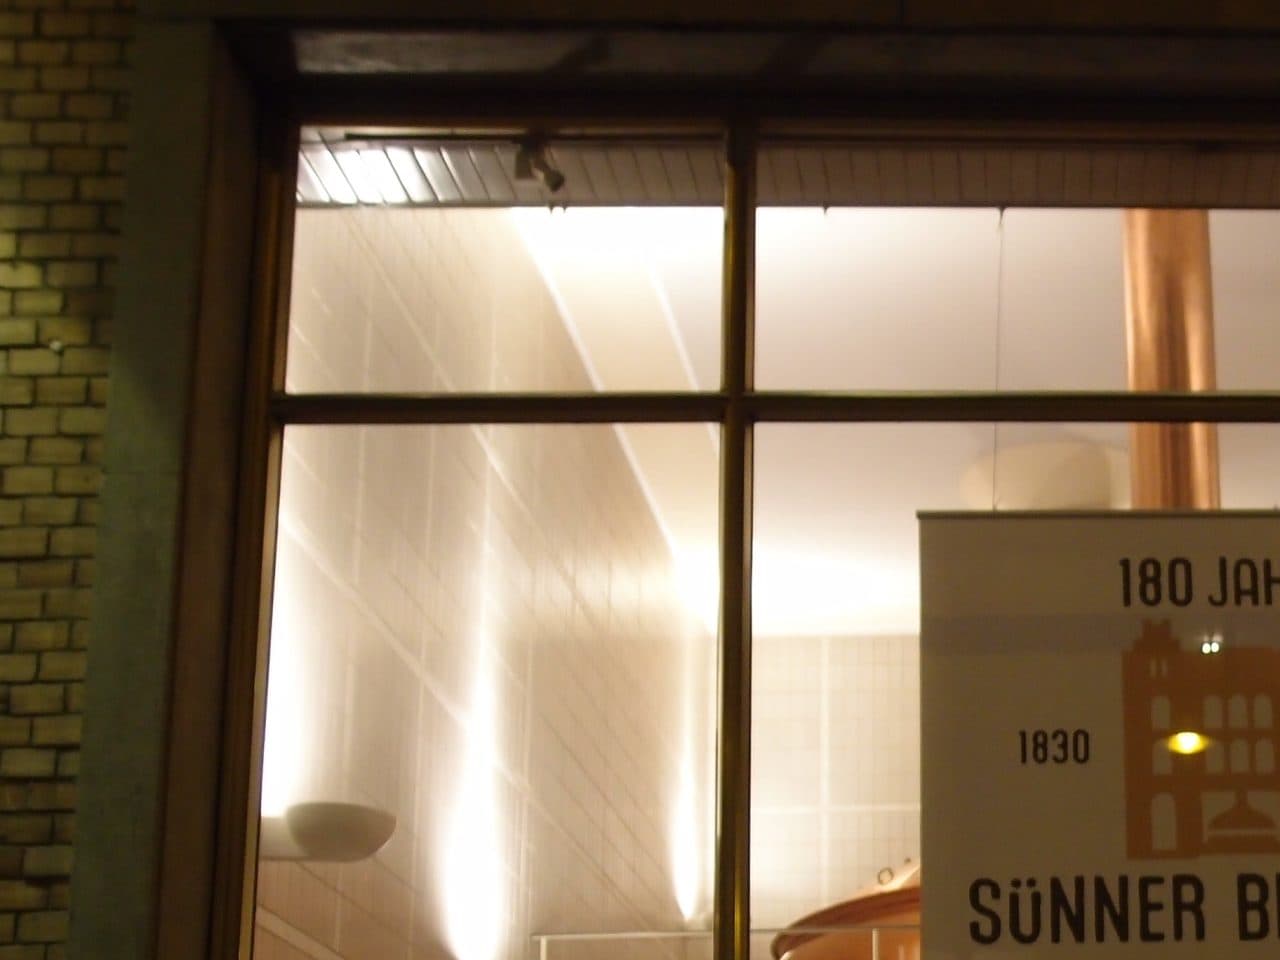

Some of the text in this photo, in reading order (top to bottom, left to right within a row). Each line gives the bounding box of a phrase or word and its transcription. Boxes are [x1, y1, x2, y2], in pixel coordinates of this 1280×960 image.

[1119, 557, 1193, 607] 180
[1019, 730, 1090, 764] 1830
[968, 875, 1205, 944] SÜNNER
